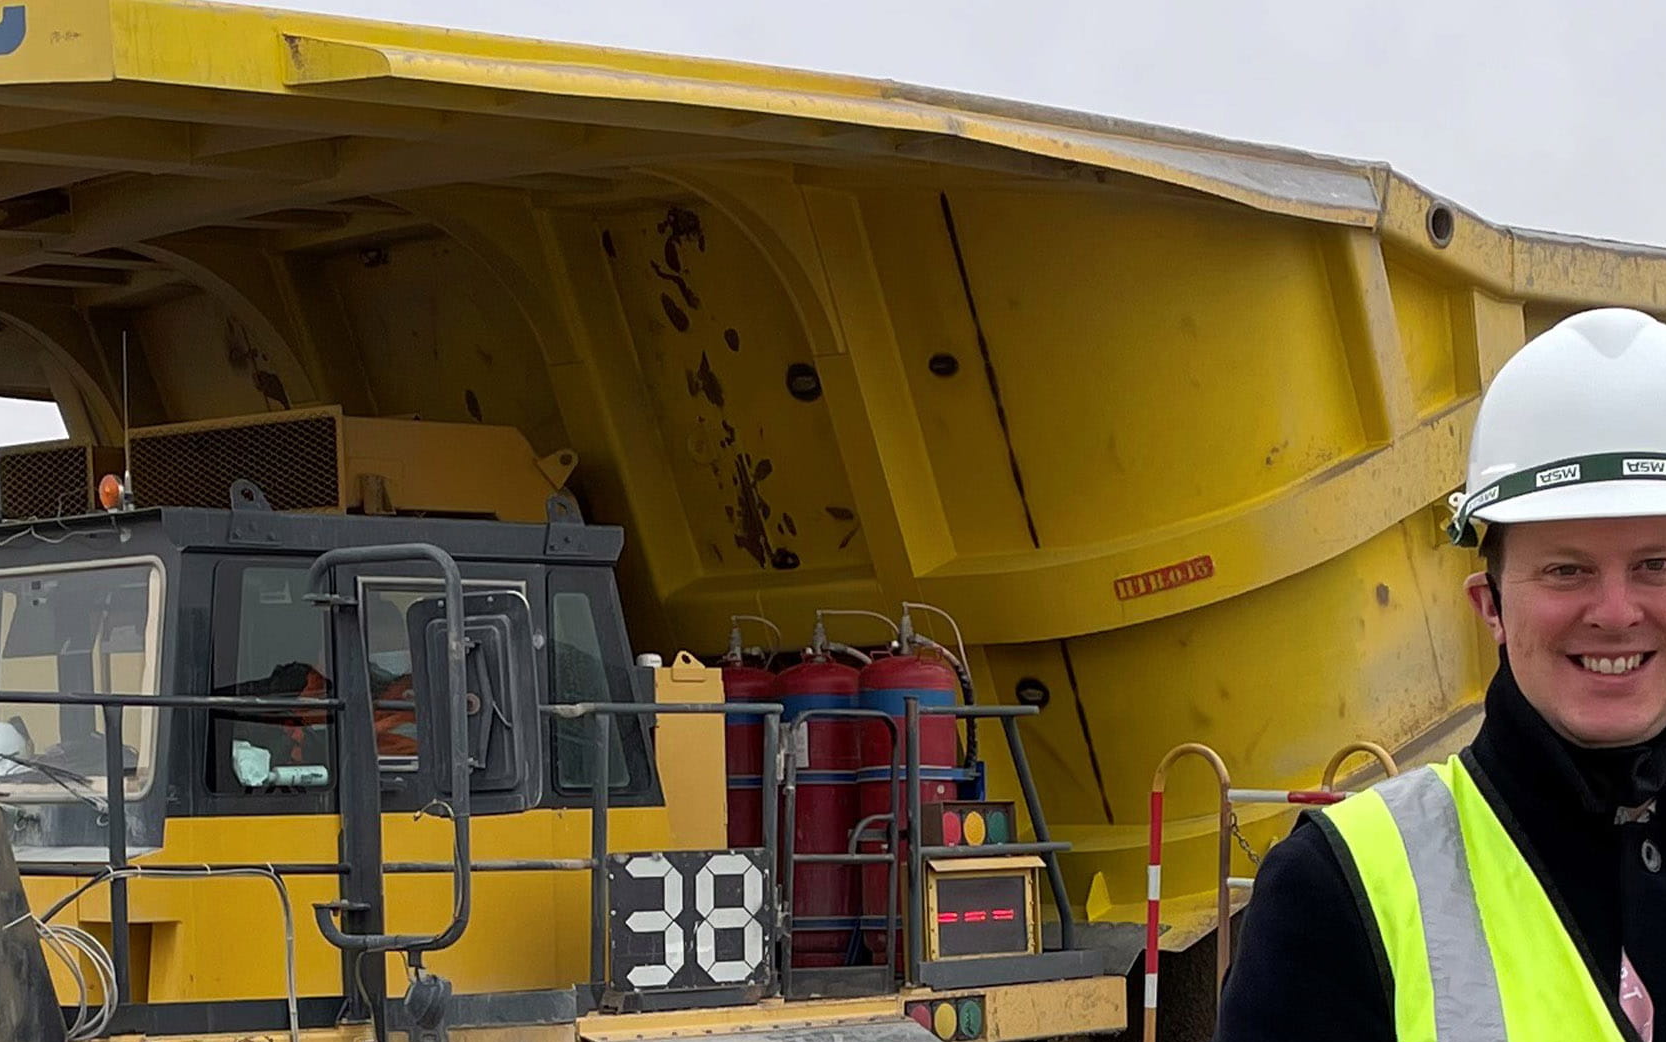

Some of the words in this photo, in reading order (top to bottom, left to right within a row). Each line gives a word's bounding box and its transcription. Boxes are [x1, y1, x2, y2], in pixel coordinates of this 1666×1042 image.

[1539, 466, 1577, 483] MSA
[1625, 462, 1665, 473] MSA
[624, 855, 765, 986] 38
